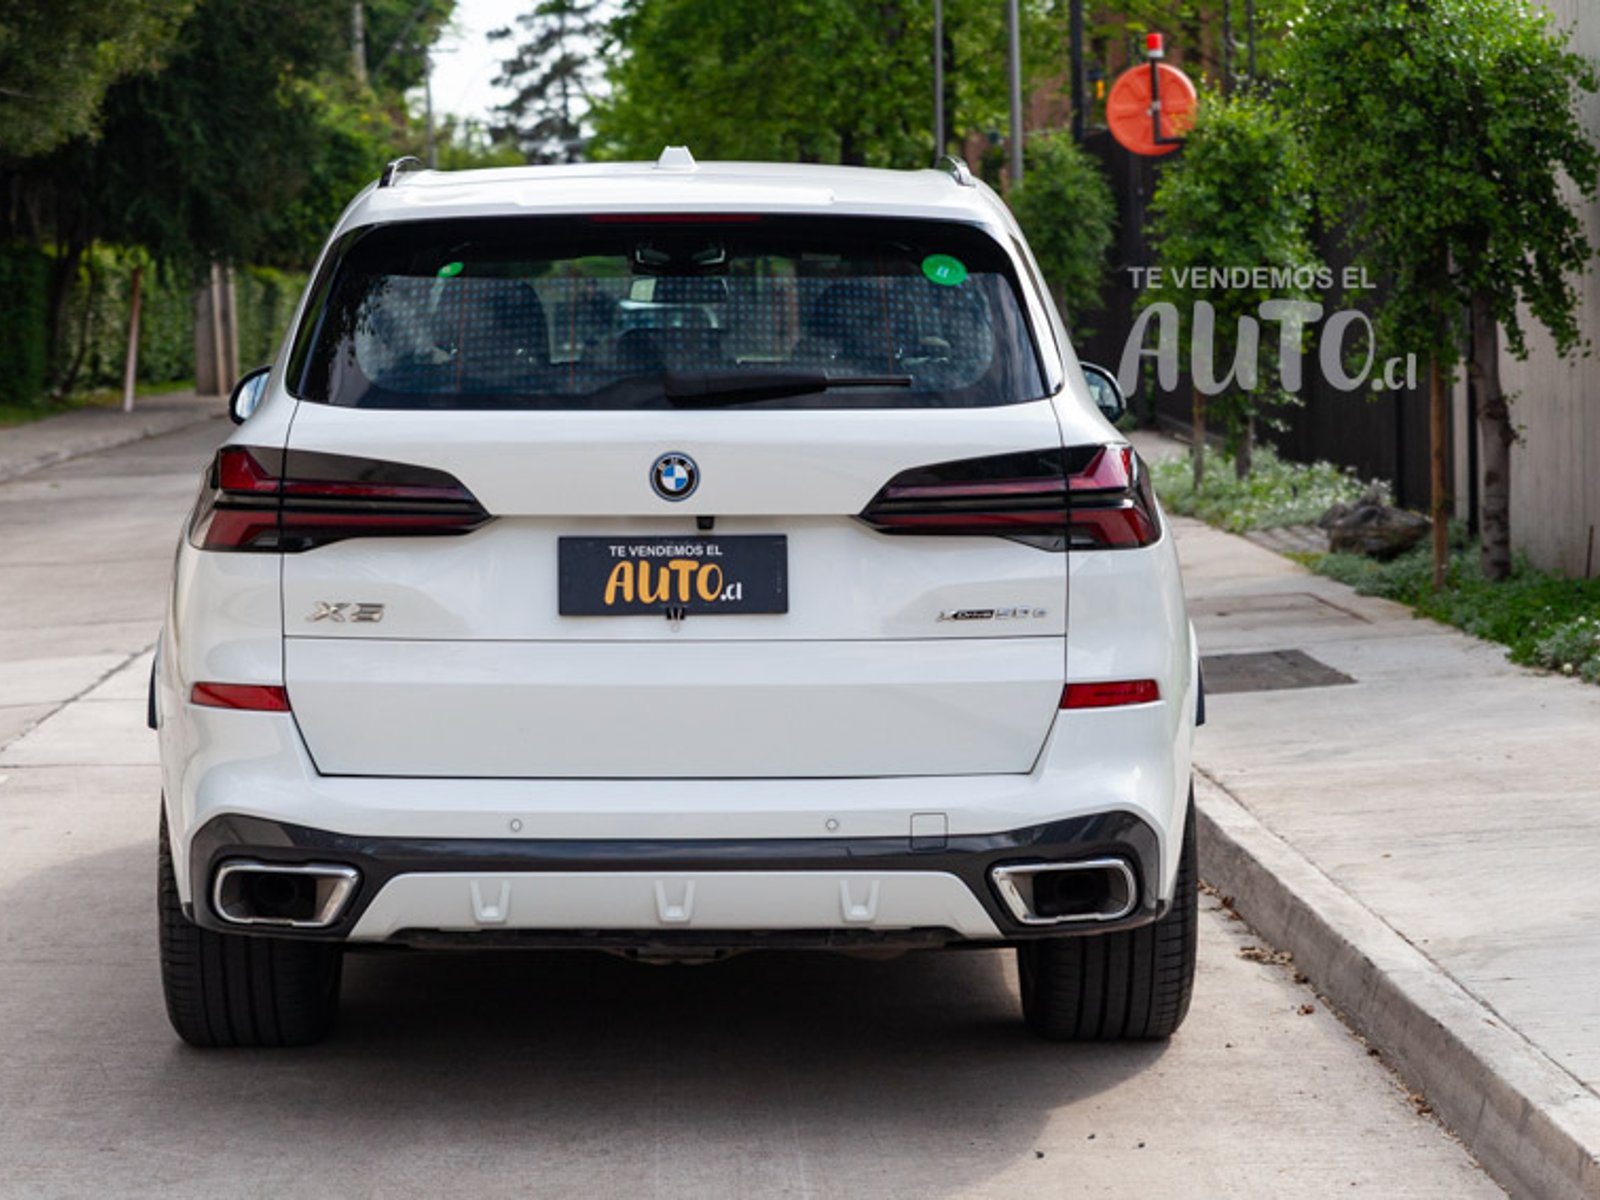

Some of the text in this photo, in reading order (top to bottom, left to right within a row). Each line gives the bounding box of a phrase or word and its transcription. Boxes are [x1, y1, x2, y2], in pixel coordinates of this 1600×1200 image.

[609, 543, 723, 557] TE VENDEMOS EL
